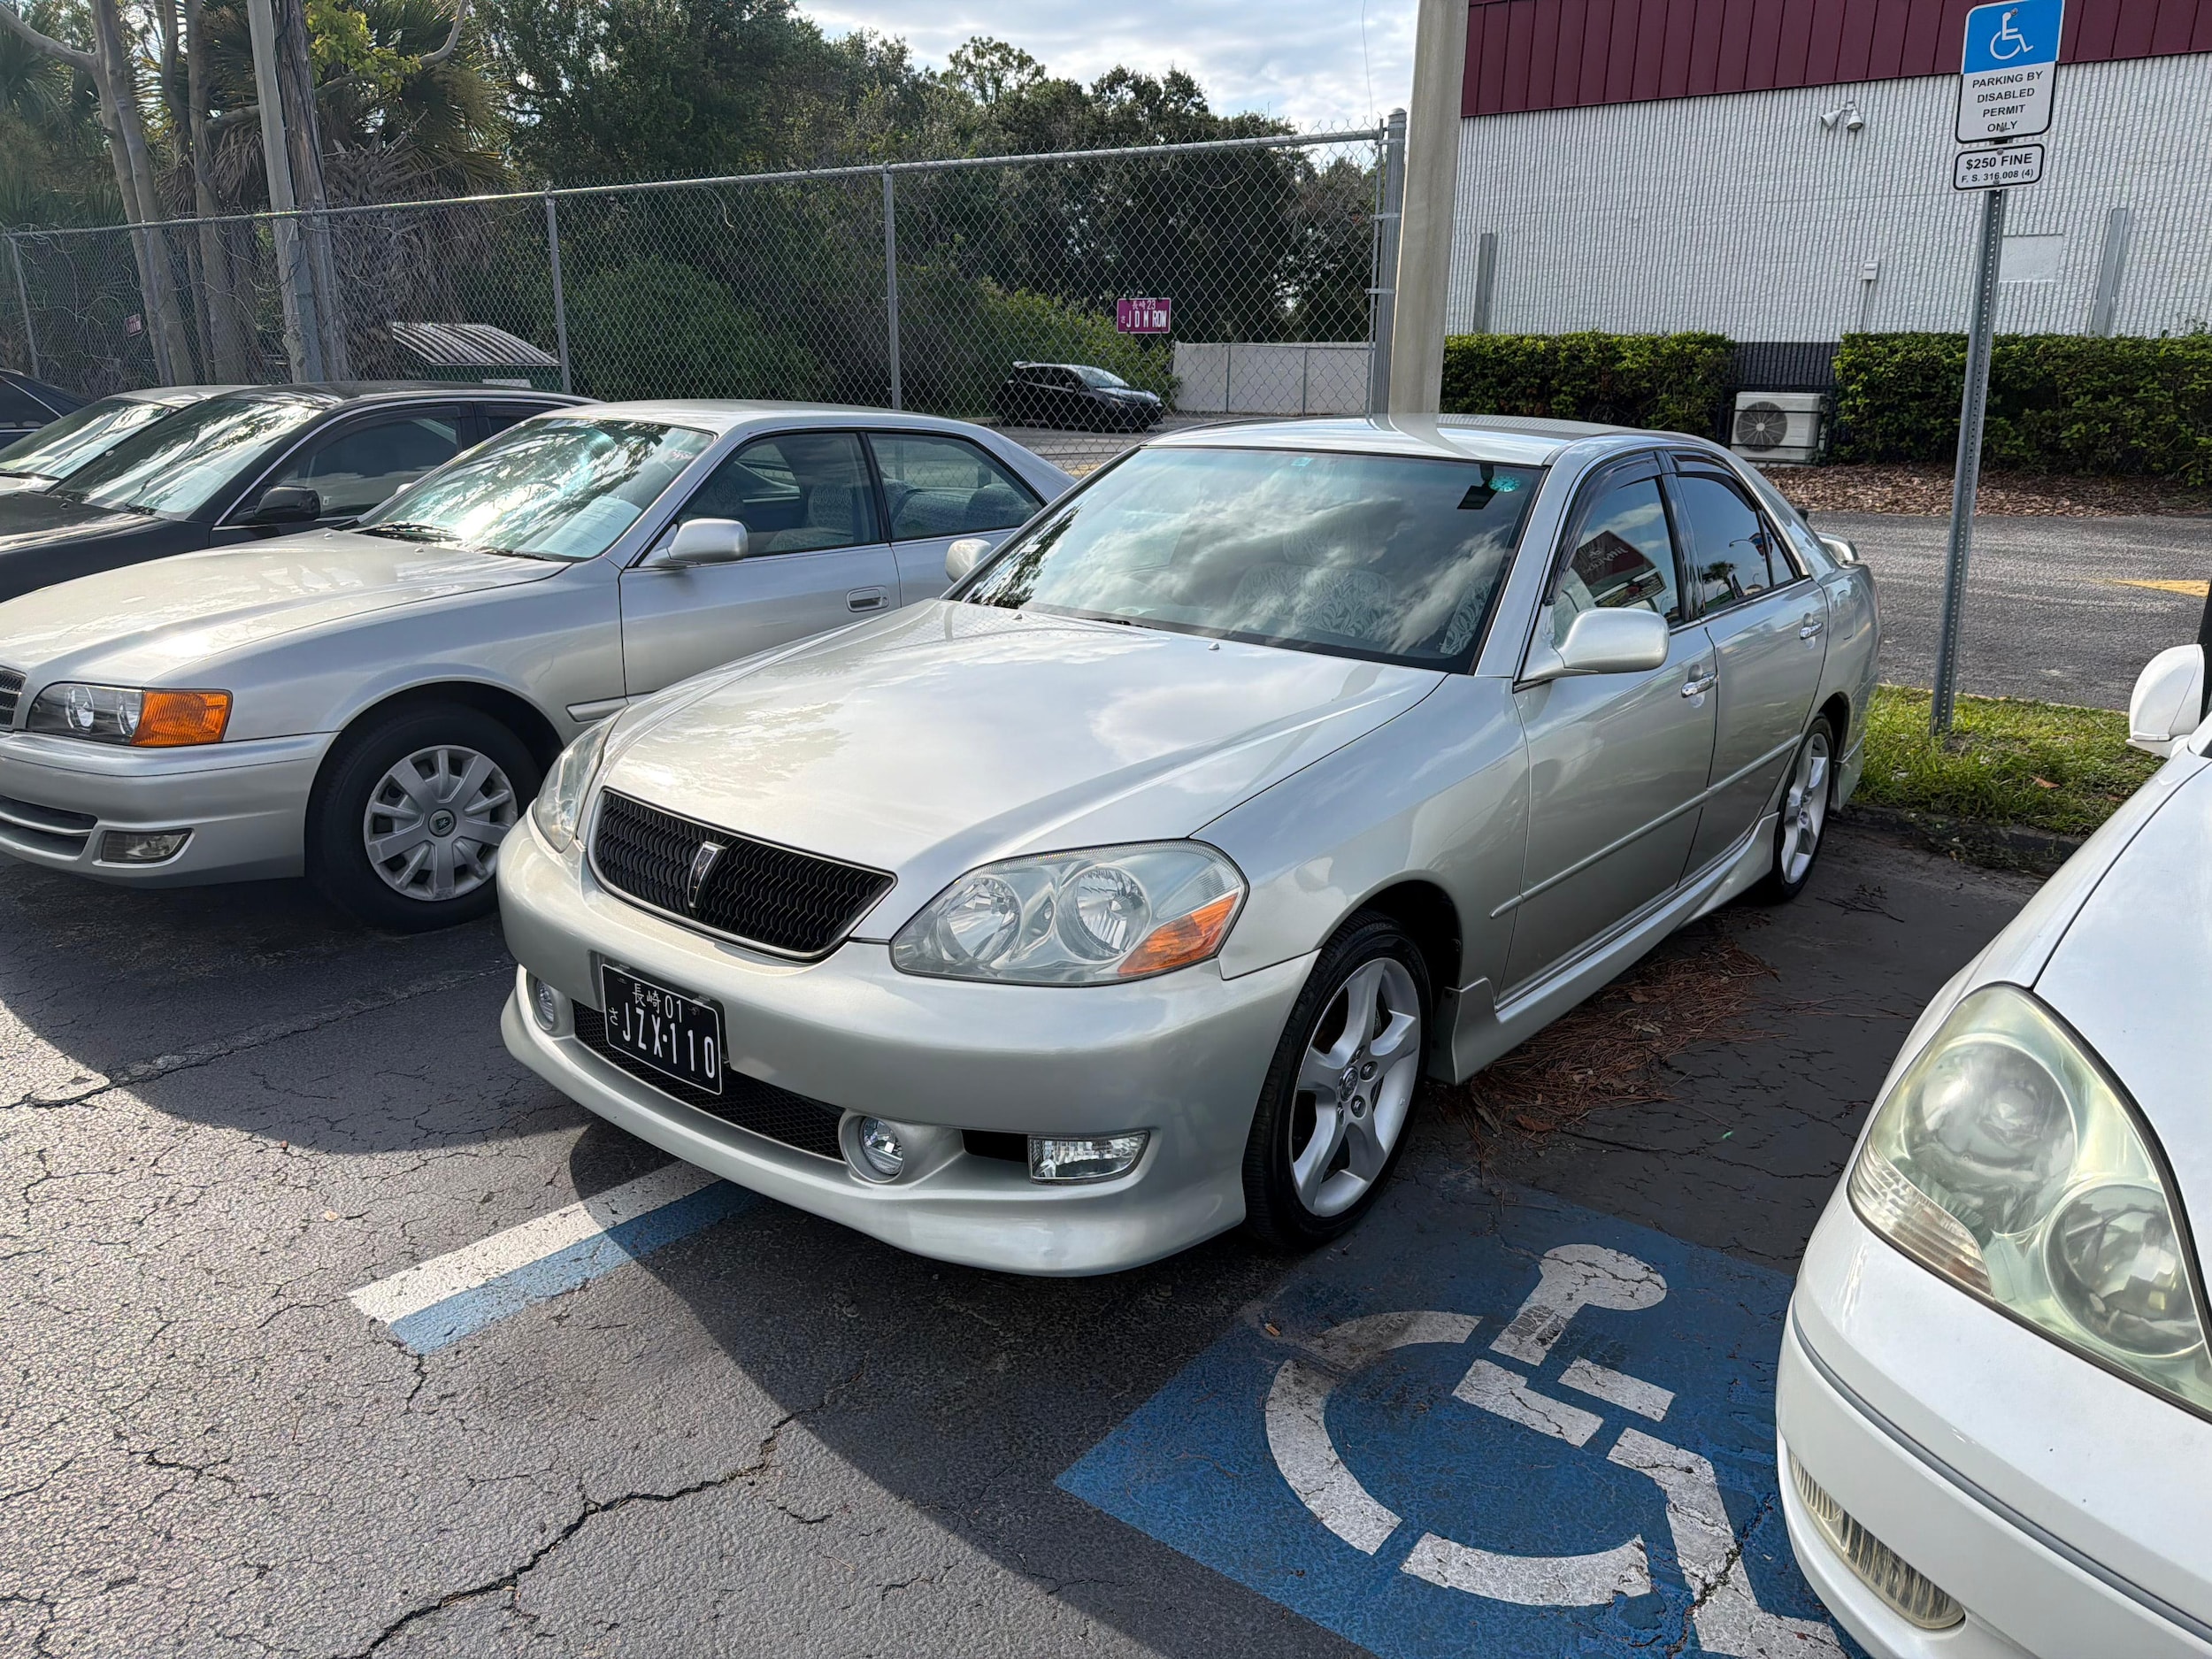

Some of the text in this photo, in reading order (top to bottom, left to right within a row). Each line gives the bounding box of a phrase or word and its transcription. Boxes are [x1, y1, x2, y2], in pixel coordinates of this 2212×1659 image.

[1972, 71, 2044, 88] PARKING BY
[1977, 88, 2035, 104] DISABLED
[1982, 104, 2026, 118] PERMIT
[1987, 120, 2018, 133] ONLY
[1965, 153, 2033, 171] $250 FINE
[1971, 173, 1980, 182] S.
[1983, 170, 2019, 180] 316.008
[2021, 168, 2034, 180] (4)
[1147, 300, 1156, 310] 23
[1152, 310, 1167, 327] ROW
[632, 982, 682, 1023] 長崎 01
[608, 1007, 618, 1026] さ
